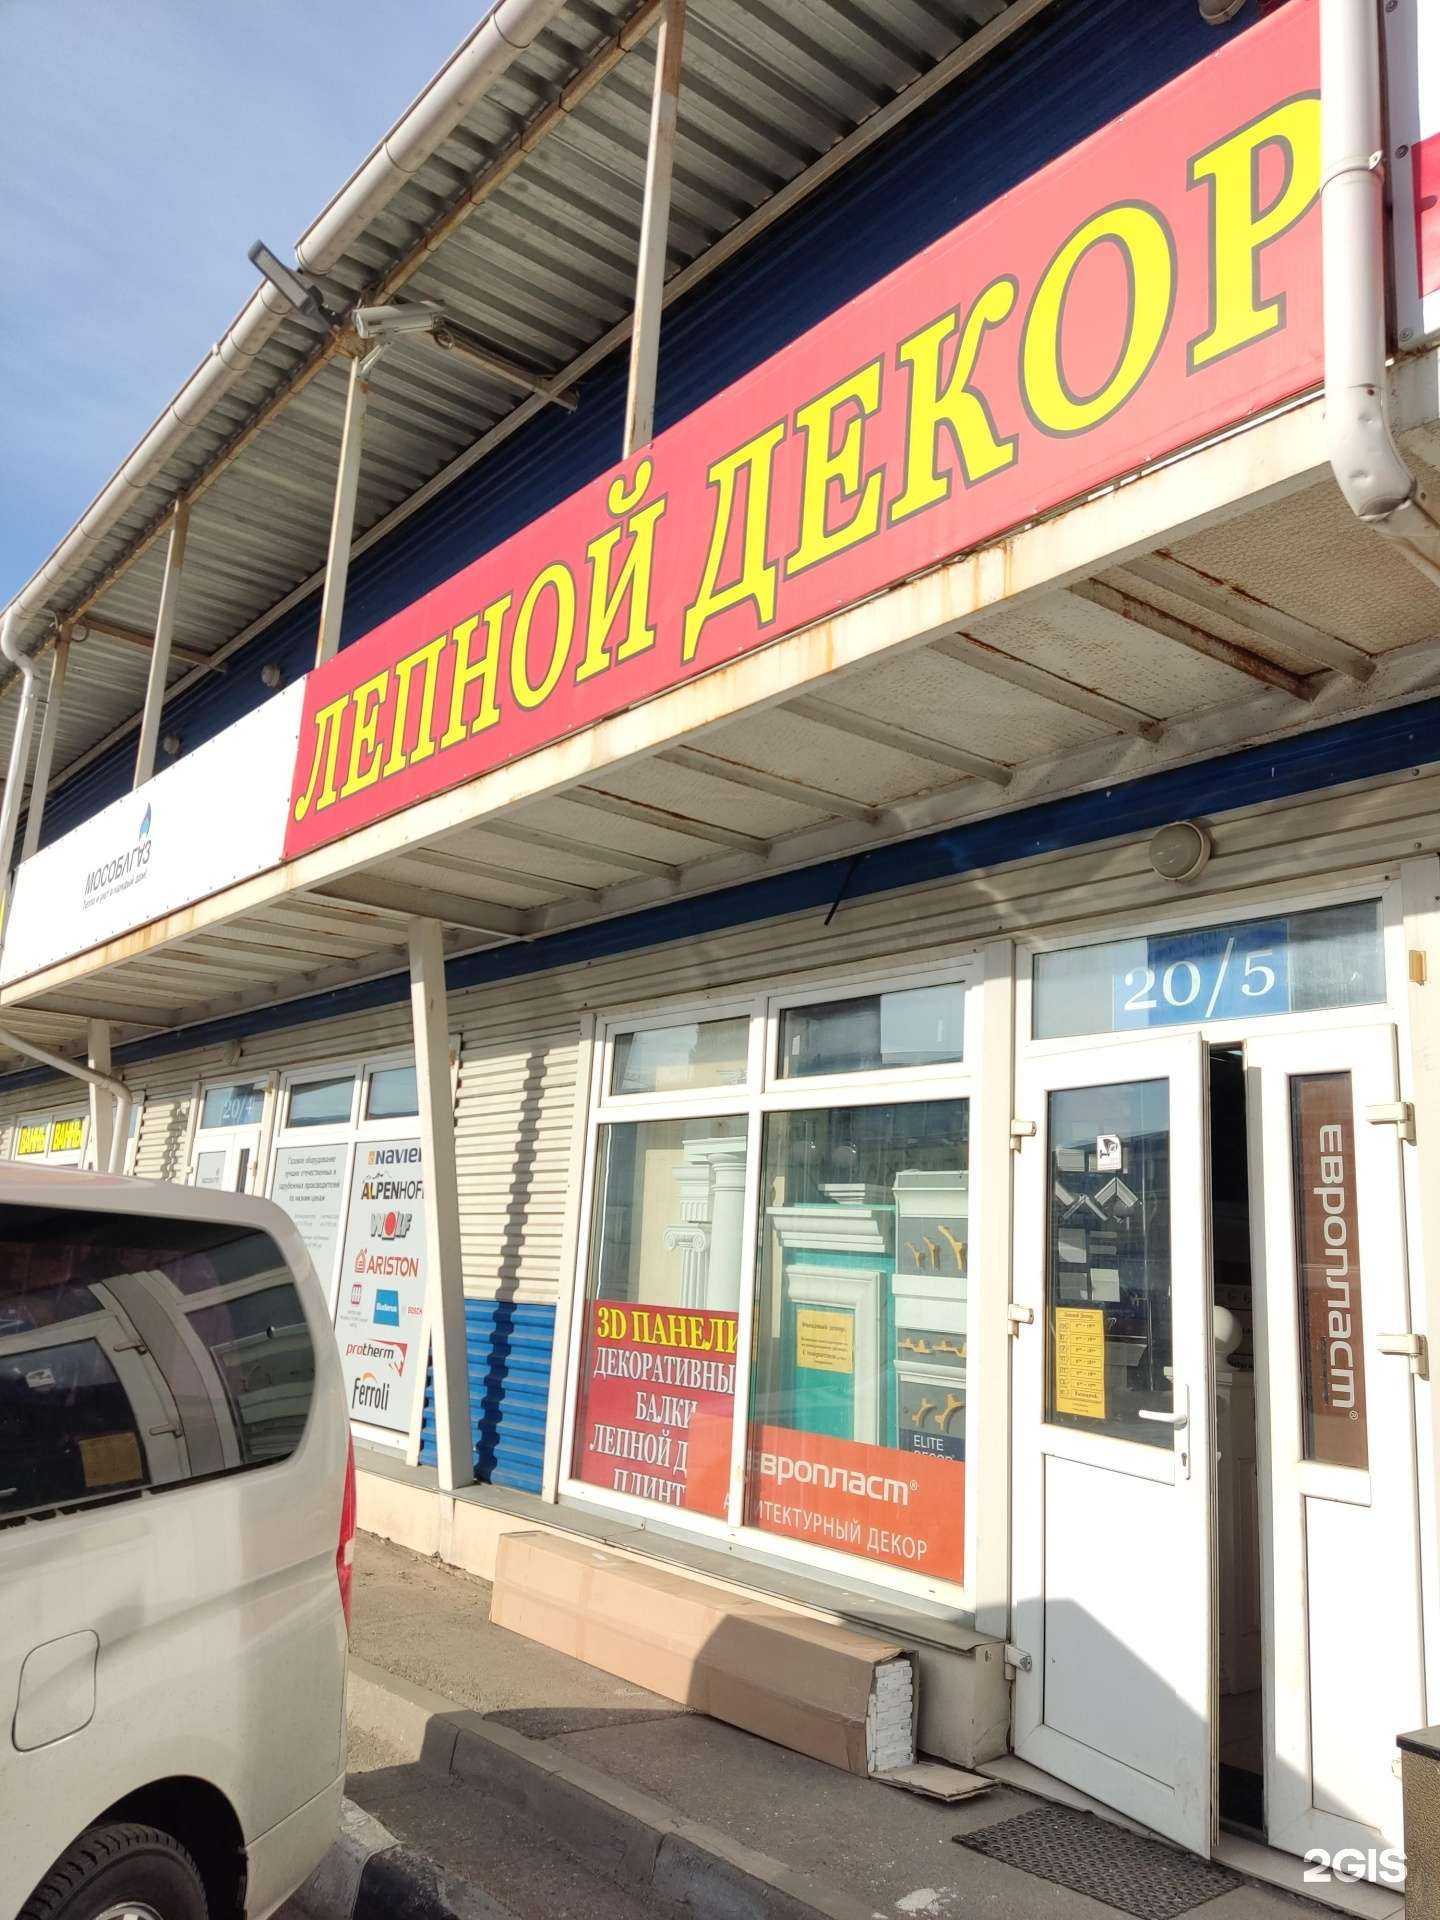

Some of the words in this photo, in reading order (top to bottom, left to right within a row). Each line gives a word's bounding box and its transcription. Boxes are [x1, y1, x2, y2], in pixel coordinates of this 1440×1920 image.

[293, 455, 668, 822] ЛЕПНОЙ
[681, 89, 1322, 666] ДЕКОР
[1123, 936, 1276, 1018] 20/5
[361, 1181, 425, 1200] ALPENHOF
[367, 1256, 419, 1277] ARISTON
[597, 1306, 627, 1340] 3D
[346, 1342, 394, 1360] protherm
[590, 1424, 671, 1467] ЛЕПНОЙ
[912, 1433, 945, 1452] ELITE
[867, 1527, 928, 1561] ДЕКОР
